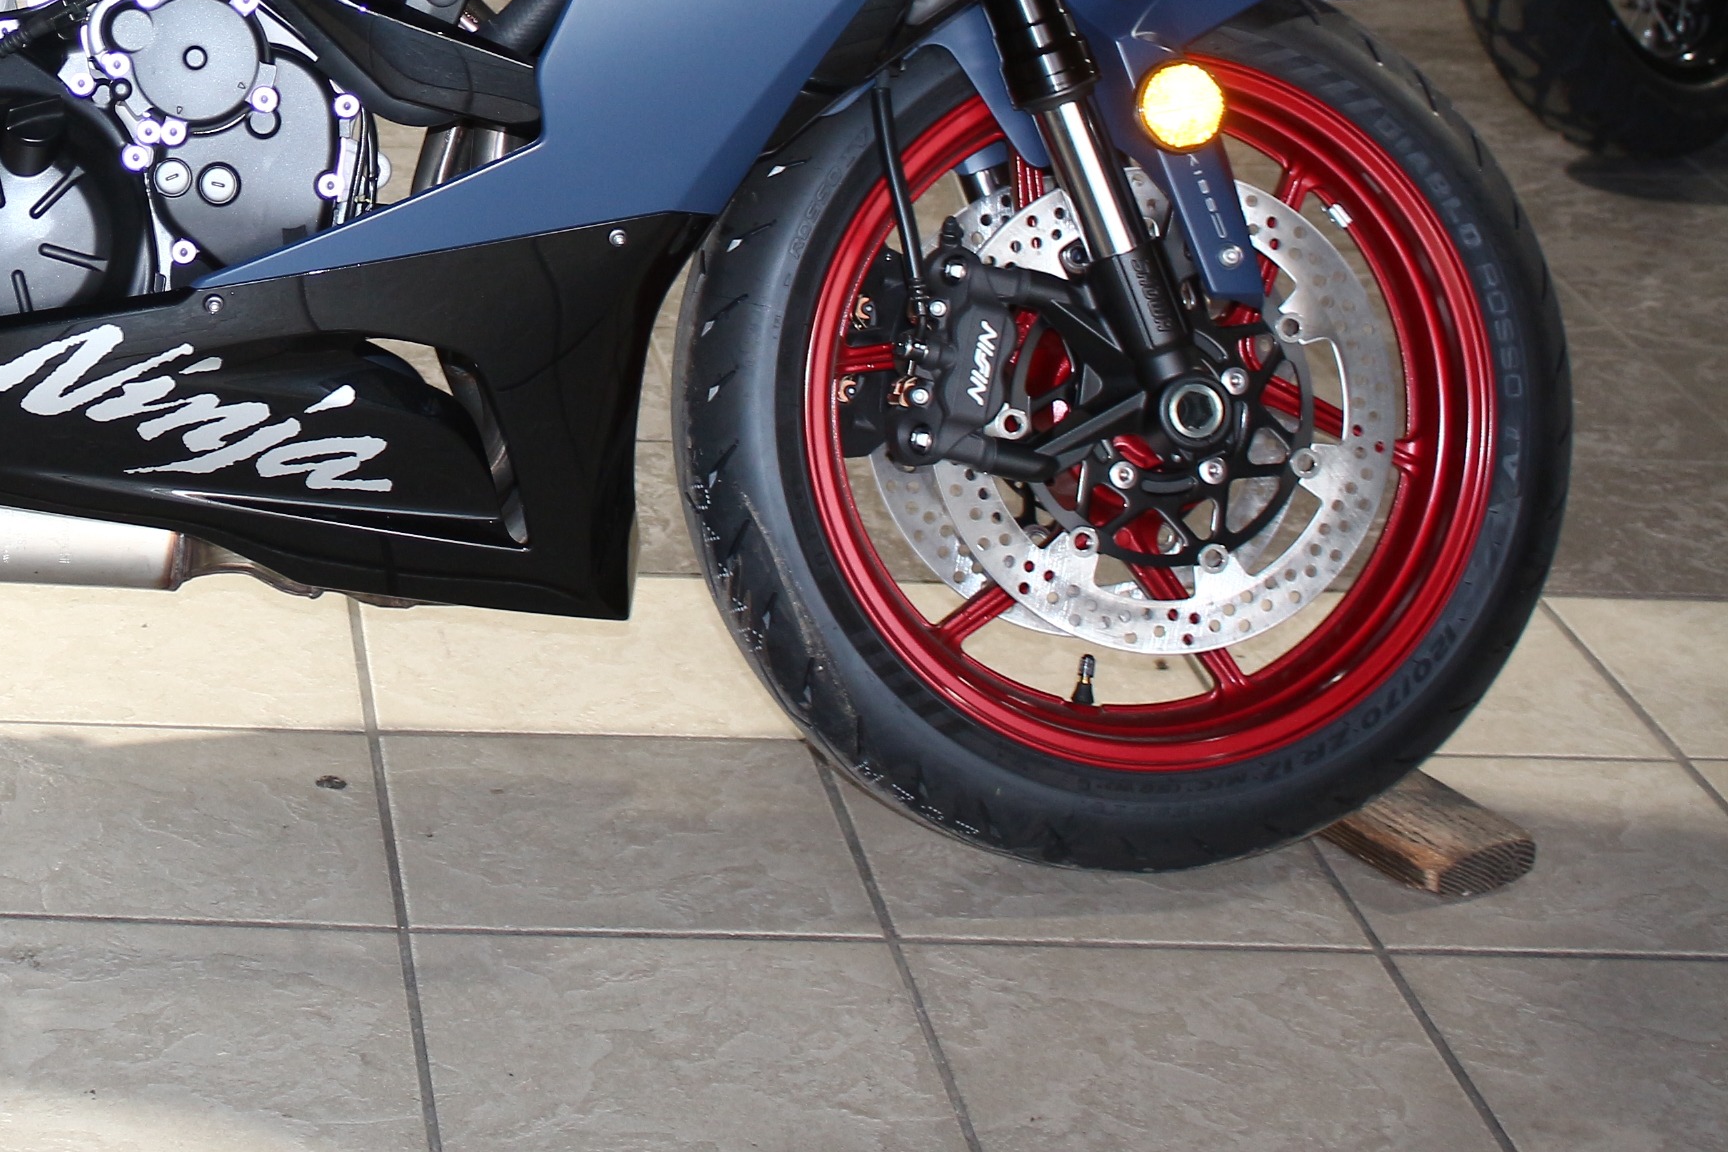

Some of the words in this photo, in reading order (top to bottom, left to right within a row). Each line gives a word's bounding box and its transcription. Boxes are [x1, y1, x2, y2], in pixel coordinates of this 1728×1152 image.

[787, 164, 843, 261] ROSSO
[1376, 114, 1483, 250] DIABLO
[1476, 262, 1523, 400] ROSSO
[967, 320, 998, 406] NISSIN
